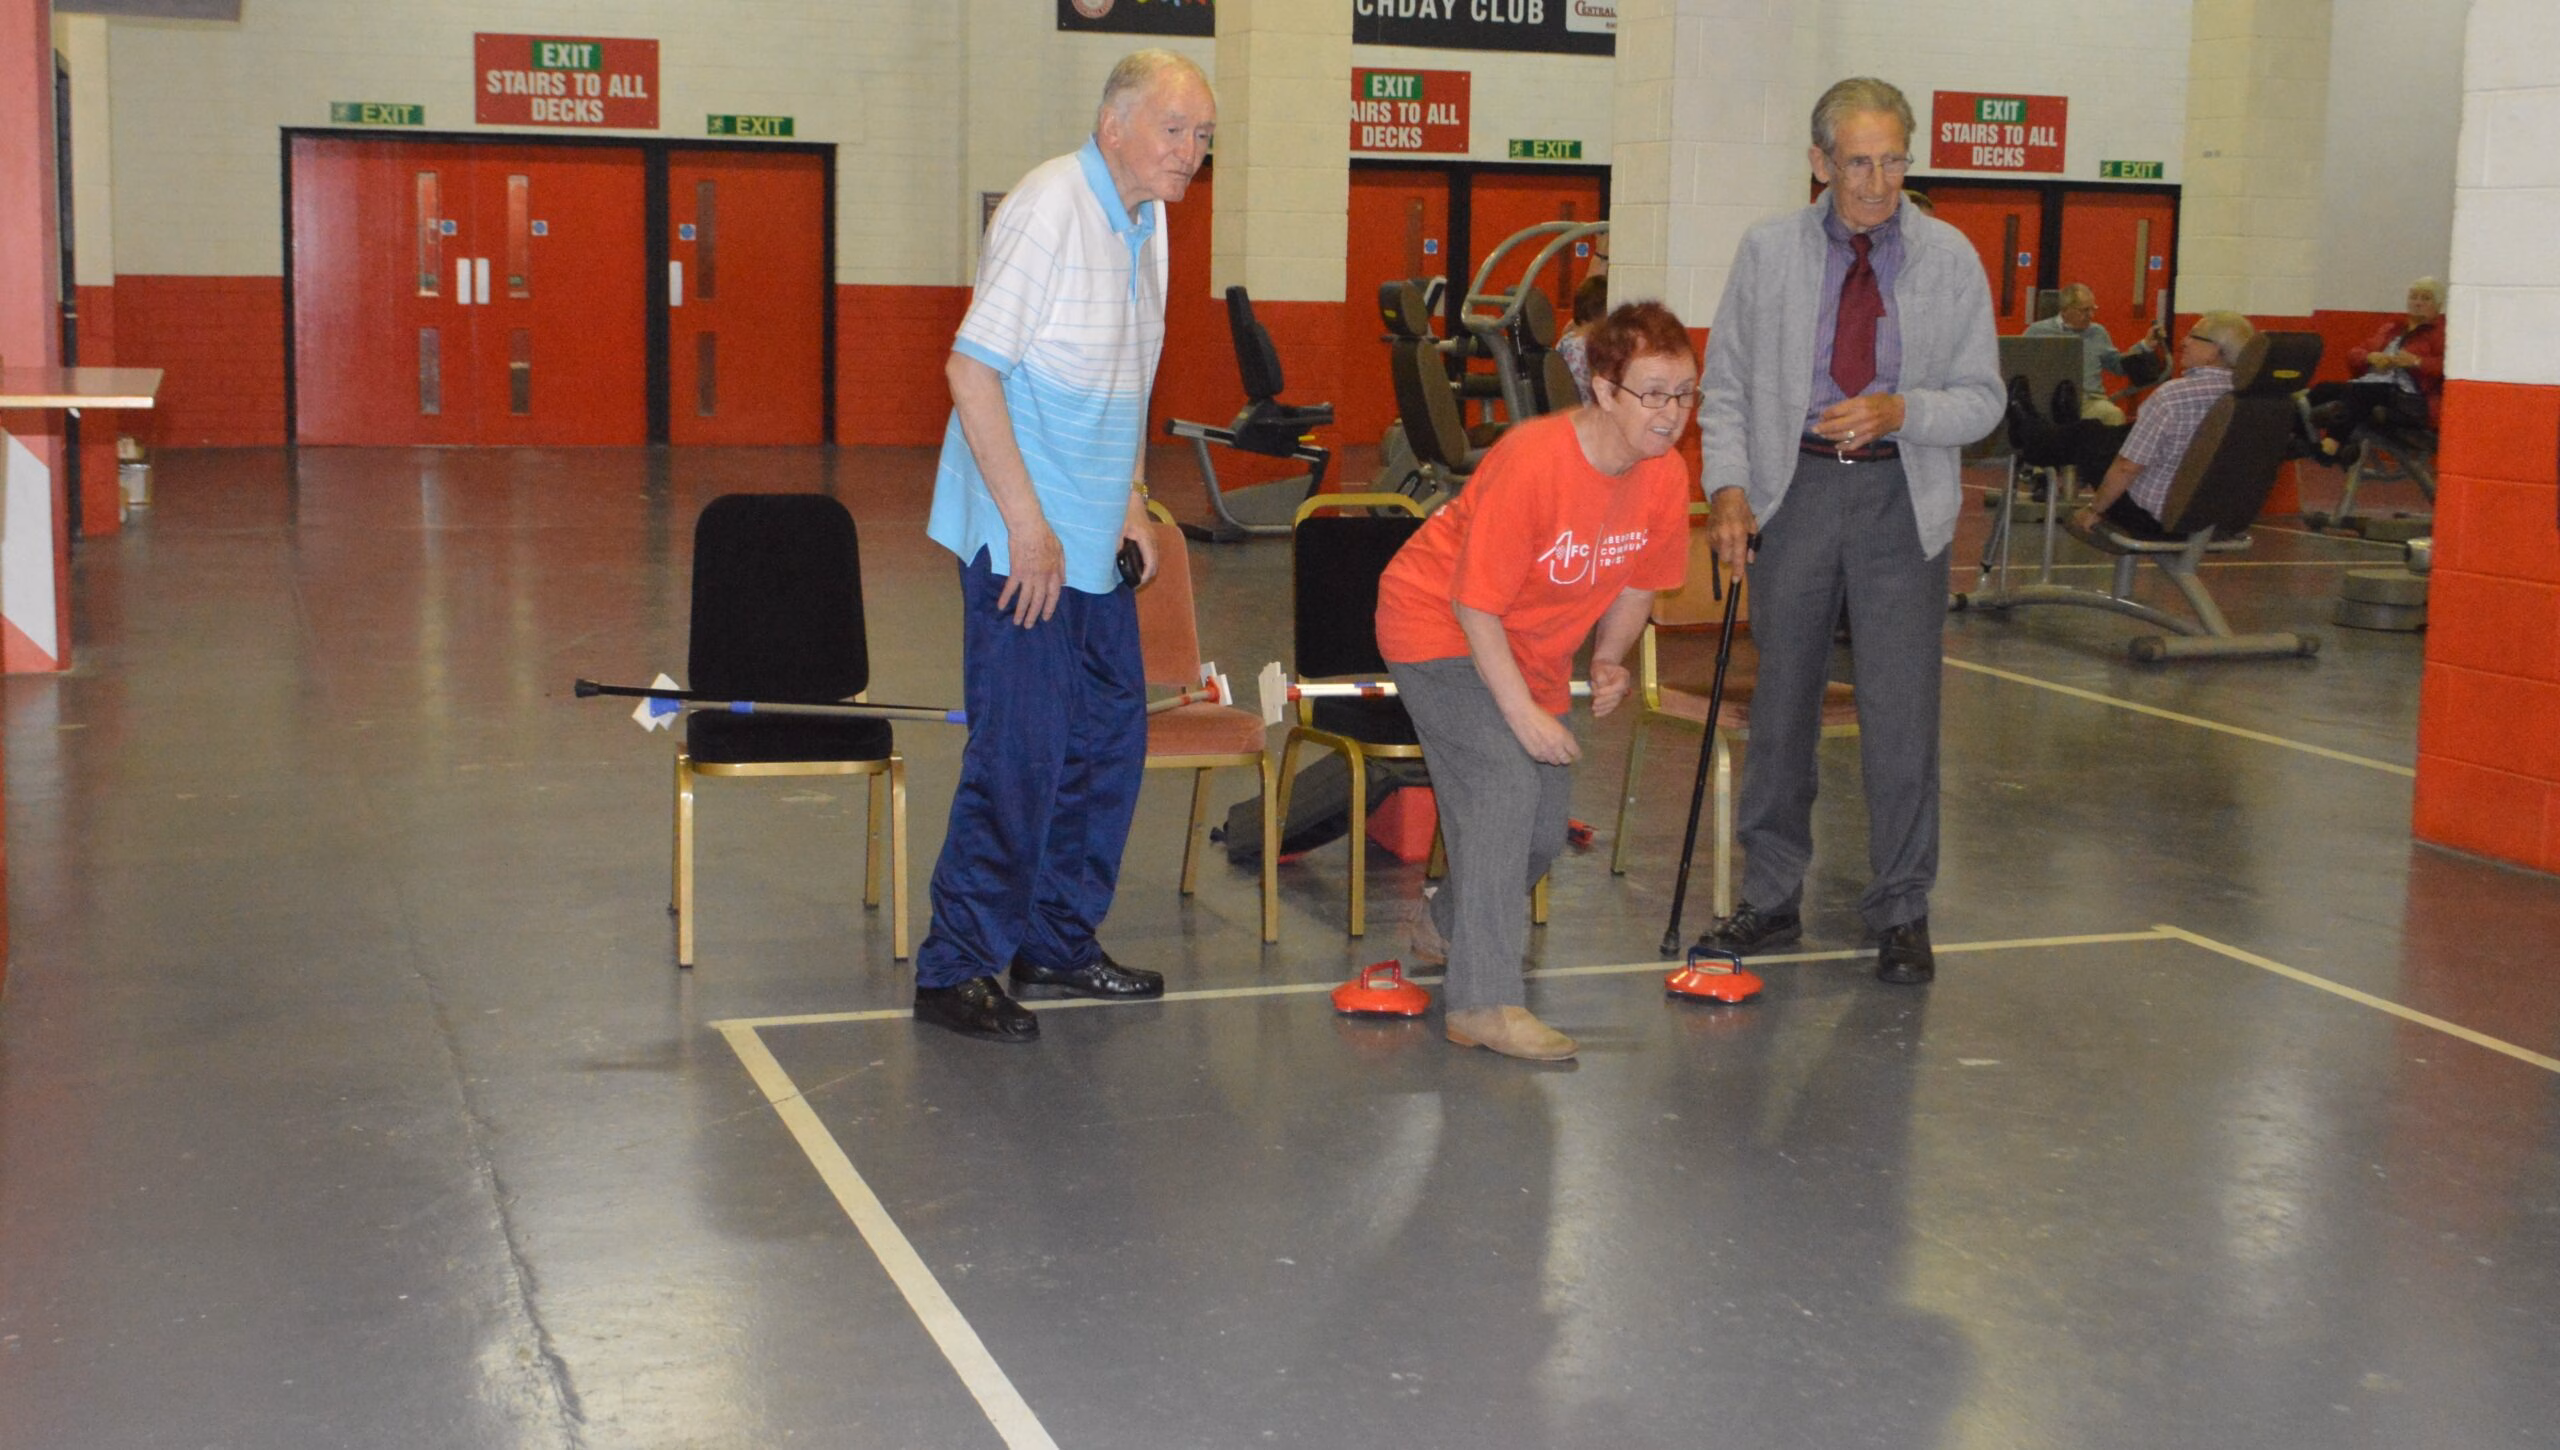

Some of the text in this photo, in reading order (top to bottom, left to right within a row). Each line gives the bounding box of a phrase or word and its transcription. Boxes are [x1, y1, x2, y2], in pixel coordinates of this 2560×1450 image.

[1471, 0, 1544, 24] CLUB
[541, 43, 593, 68] EXIT
[486, 69, 648, 99] STAIRS TO ALL
[1372, 75, 1415, 98] EXIT
[362, 104, 414, 124] EXIT
[532, 97, 605, 123] DECKS
[1397, 102, 1421, 124] TO
[1427, 103, 1460, 126] ALL
[1982, 99, 2020, 121] EXIT
[736, 116, 784, 136] EXIT
[1362, 126, 1423, 149] DECKS
[1941, 122, 2058, 148] STAIRS TO ALL
[1533, 141, 1574, 159] EXIT
[1971, 146, 2025, 168] DECKS
[2121, 162, 2156, 178] EXIT
